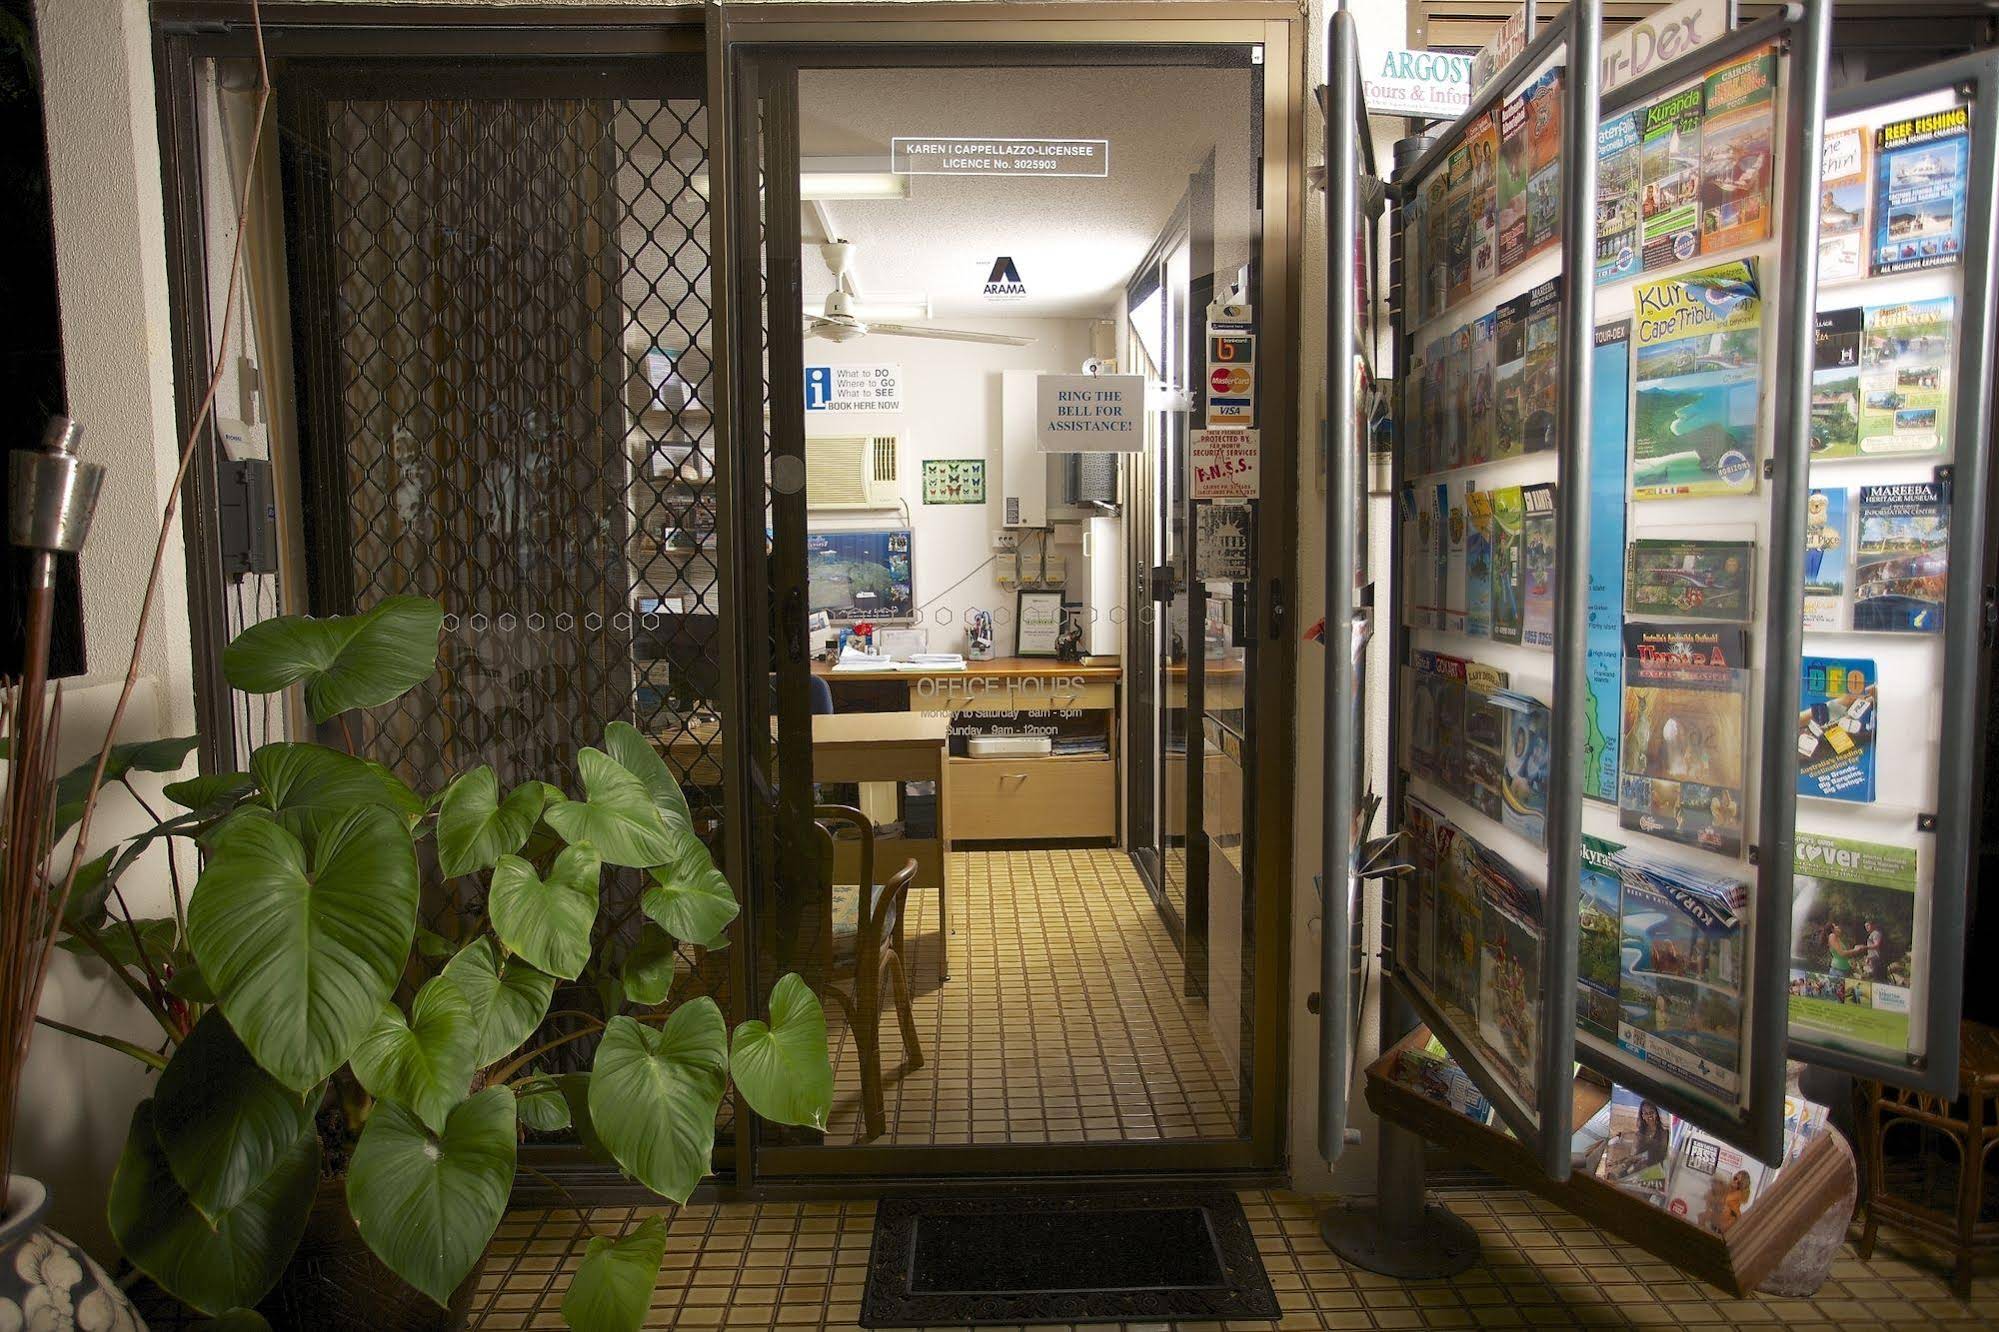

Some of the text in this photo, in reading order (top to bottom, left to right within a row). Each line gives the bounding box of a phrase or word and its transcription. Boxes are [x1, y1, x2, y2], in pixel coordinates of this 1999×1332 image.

[1410, 84, 1425, 101] &
[1647, 90, 1700, 128] Kuranda
[1884, 121, 1912, 141] REEF
[1915, 108, 1967, 134] FISHING
[906, 144, 946, 154] KAREN
[954, 145, 1094, 157] CAPPELLAZZO-LICENSEE
[943, 159, 1057, 170] LICENCE No. 3025903
[983, 284, 1027, 295] ARAMA
[1595, 326, 1626, 344] TOUR-DEX
[1640, 316, 1676, 343] Cape
[837, 369, 890, 378] What to DO
[837, 379, 896, 388] Where to GO
[1211, 377, 1250, 385] MasterCard
[837, 389, 894, 398] What to SEE
[1058, 391, 1122, 401] RING THE
[828, 401, 900, 411] BOOK HERE NOW
[1058, 406, 1122, 417] BELL FOR
[1219, 407, 1241, 416] VISA
[1047, 421, 1133, 432] ASSISTANCE!
[1193, 449, 1257, 457] SECURITY SERVICES
[1197, 458, 1252, 482] F.N.S.S.
[1718, 462, 1751, 477] HORIZONS
[1871, 484, 1932, 497] MAREEBA
[1865, 493, 1938, 503] HERITAGE MUSEUM
[916, 676, 1086, 698] OFFICE HOURS
[1808, 666, 1866, 695] DFO
[920, 707, 962, 721] Monday
[962, 707, 973, 718] to
[974, 707, 1020, 721] Saturday
[1028, 707, 1051, 718] 8am
[1059, 707, 1083, 720] 5pm
[946, 724, 983, 736] Sunday
[991, 724, 1014, 736] 9am
[1022, 724, 1059, 736] 12noon
[1818, 766, 1858, 783] Big Brands.
[1818, 771, 1864, 790] Big Bargains.
[1823, 778, 1866, 795] Big Savings.
